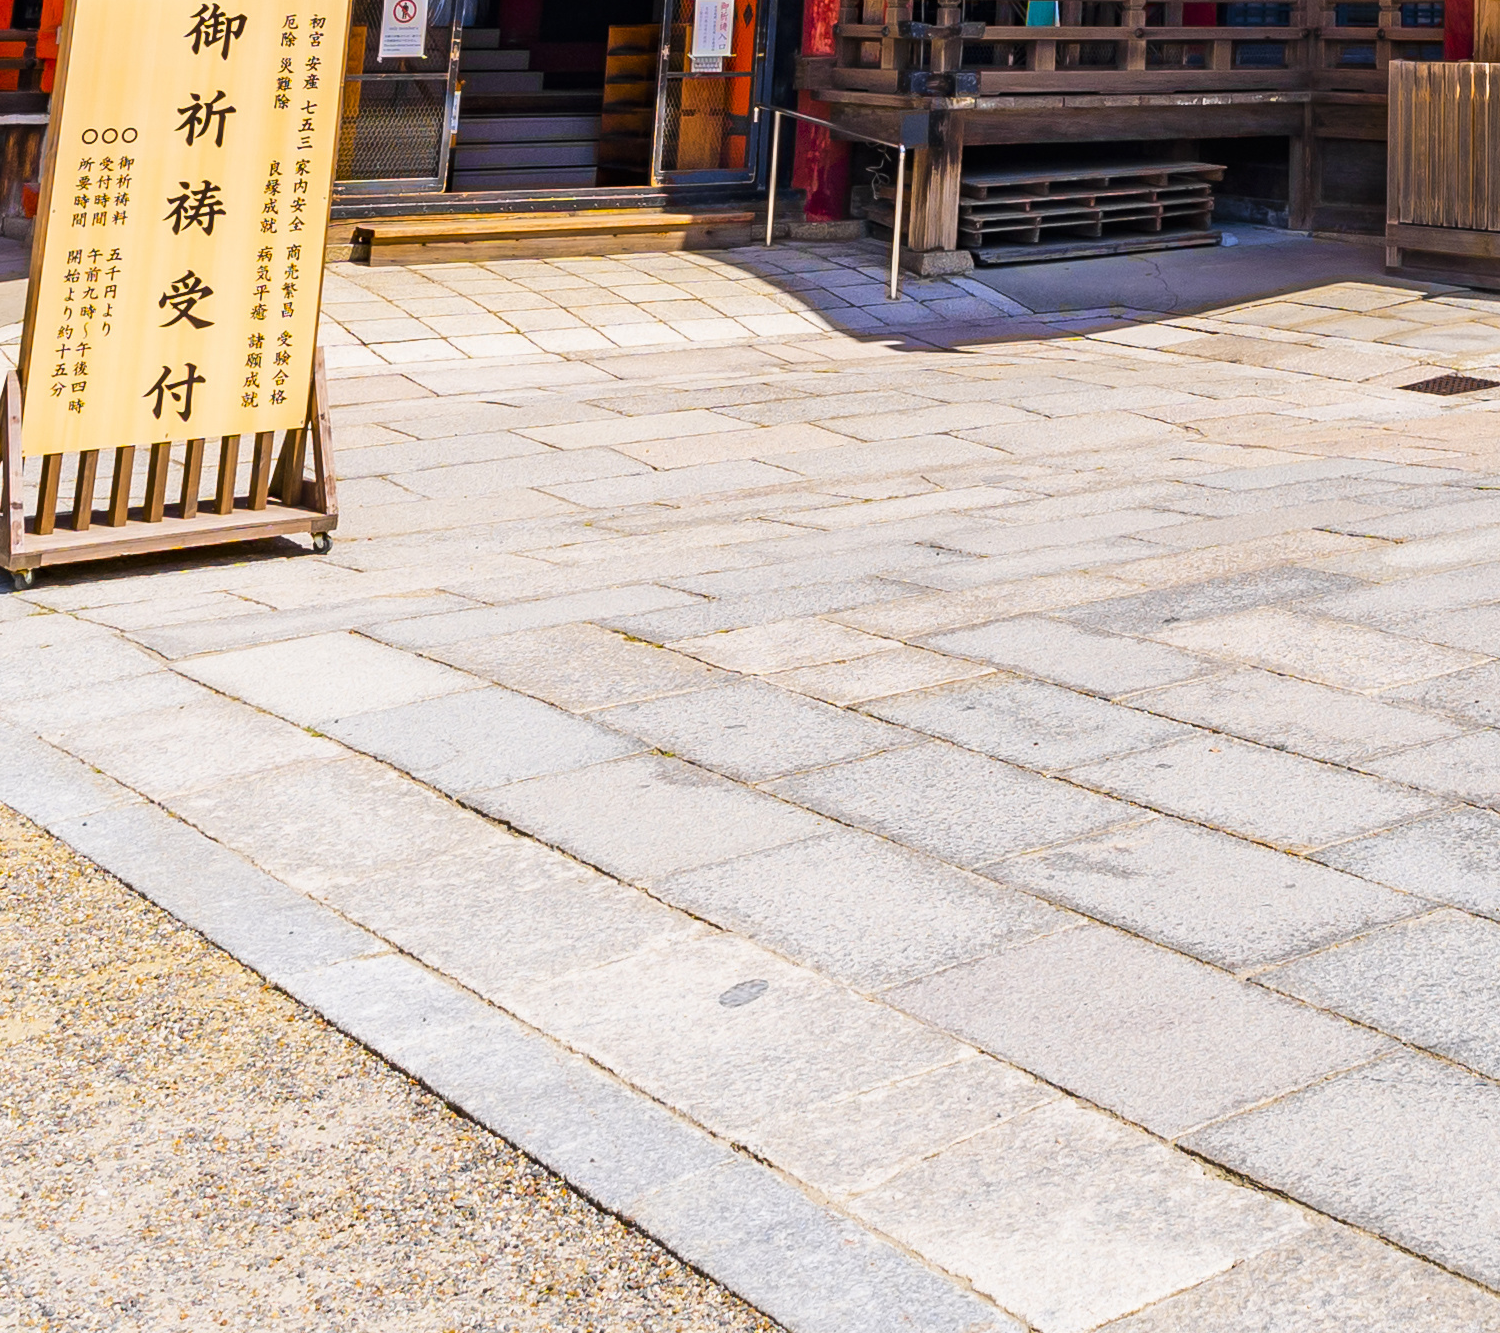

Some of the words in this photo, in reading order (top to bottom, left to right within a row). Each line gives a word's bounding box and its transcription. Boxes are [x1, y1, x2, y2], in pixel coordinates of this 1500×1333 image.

[281, 15, 298, 47] 厄除
[309, 15, 325, 46] 初宮
[274, 58, 293, 109] 災難除
[304, 56, 321, 89] 安産
[297, 101, 317, 149] 七五三
[71, 157, 95, 227] 所要時間
[92, 156, 114, 226] 受付時間
[112, 155, 134, 225] 御祈祷料
[144, 4, 249, 421] 御祈祷受付
[261, 161, 281, 233] 良縁成就
[290, 159, 310, 231] 家内安全
[102, 248, 122, 337] 五千円より
[251, 247, 272, 320] 病気平癒
[282, 245, 301, 317] 商売繁昌
[50, 249, 83, 397] 開始より約十五分
[242, 333, 264, 407] 諸願成就
[272, 331, 291, 404] 受験合格
